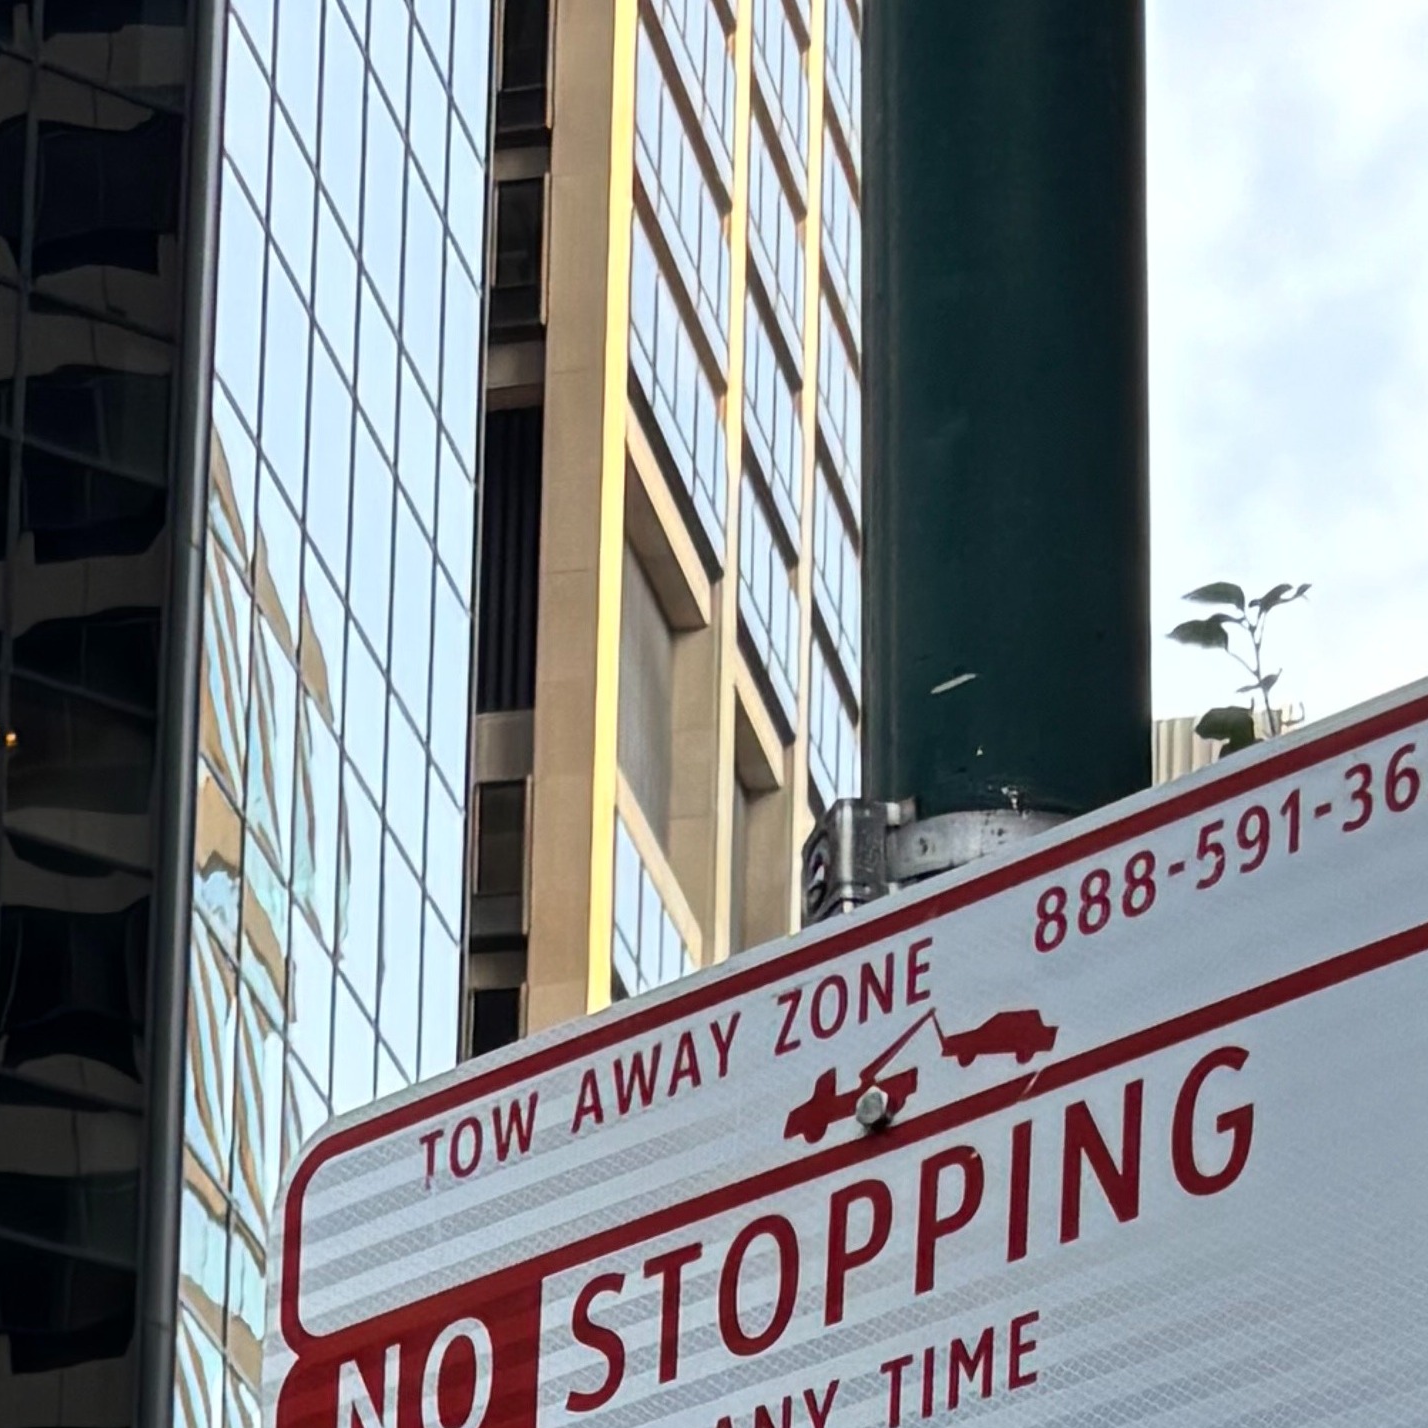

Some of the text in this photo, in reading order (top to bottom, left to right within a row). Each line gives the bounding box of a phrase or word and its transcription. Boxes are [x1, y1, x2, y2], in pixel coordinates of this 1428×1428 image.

[420, 1092, 537, 1190] TOW
[573, 1014, 740, 1133] AWAY
[775, 938, 933, 1056] ZONE
[568, 1047, 1252, 1412] STOPPING
[881, 1312, 1040, 1428] TIME
